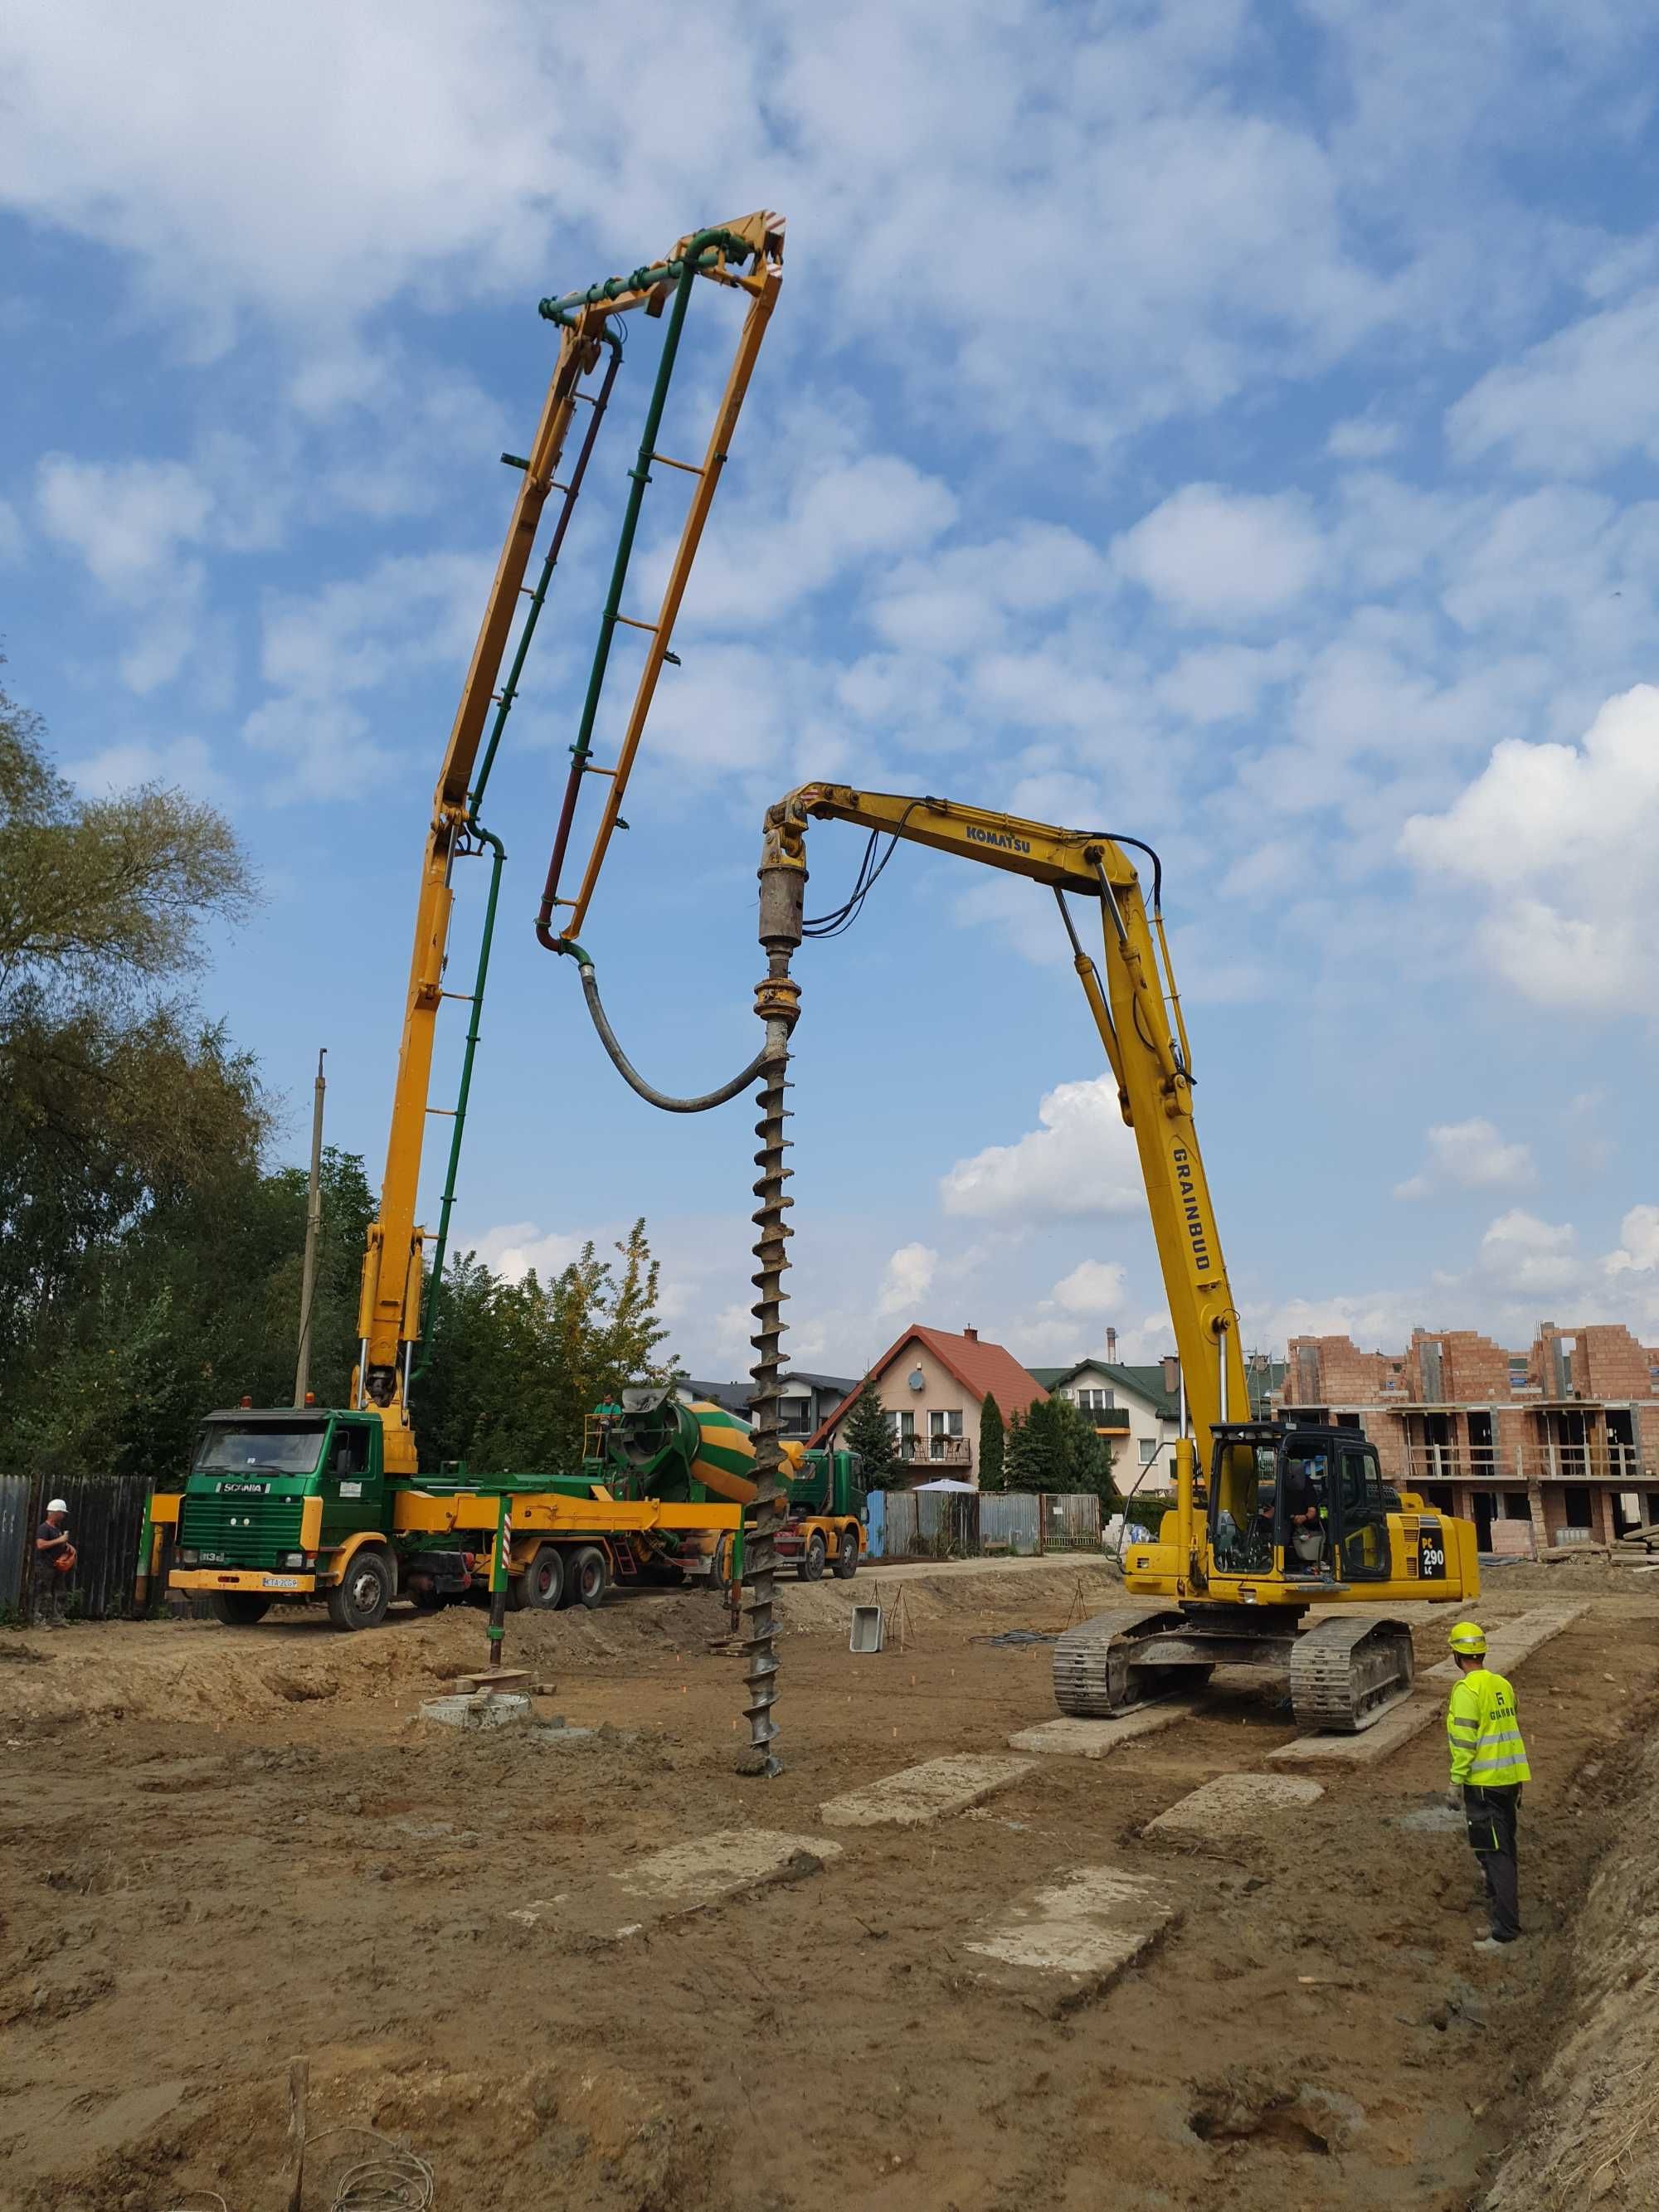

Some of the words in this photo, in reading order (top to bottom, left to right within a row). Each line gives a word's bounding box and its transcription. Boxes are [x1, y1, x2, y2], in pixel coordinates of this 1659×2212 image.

[966, 826, 1030, 853] KOMATSU
[1174, 1148, 1210, 1270] GRAINBUD
[223, 1483, 262, 1493] SCANIA
[1421, 1538, 1433, 1549] PC
[1423, 1549, 1444, 1566] 290
[1424, 1566, 1433, 1576] LC
